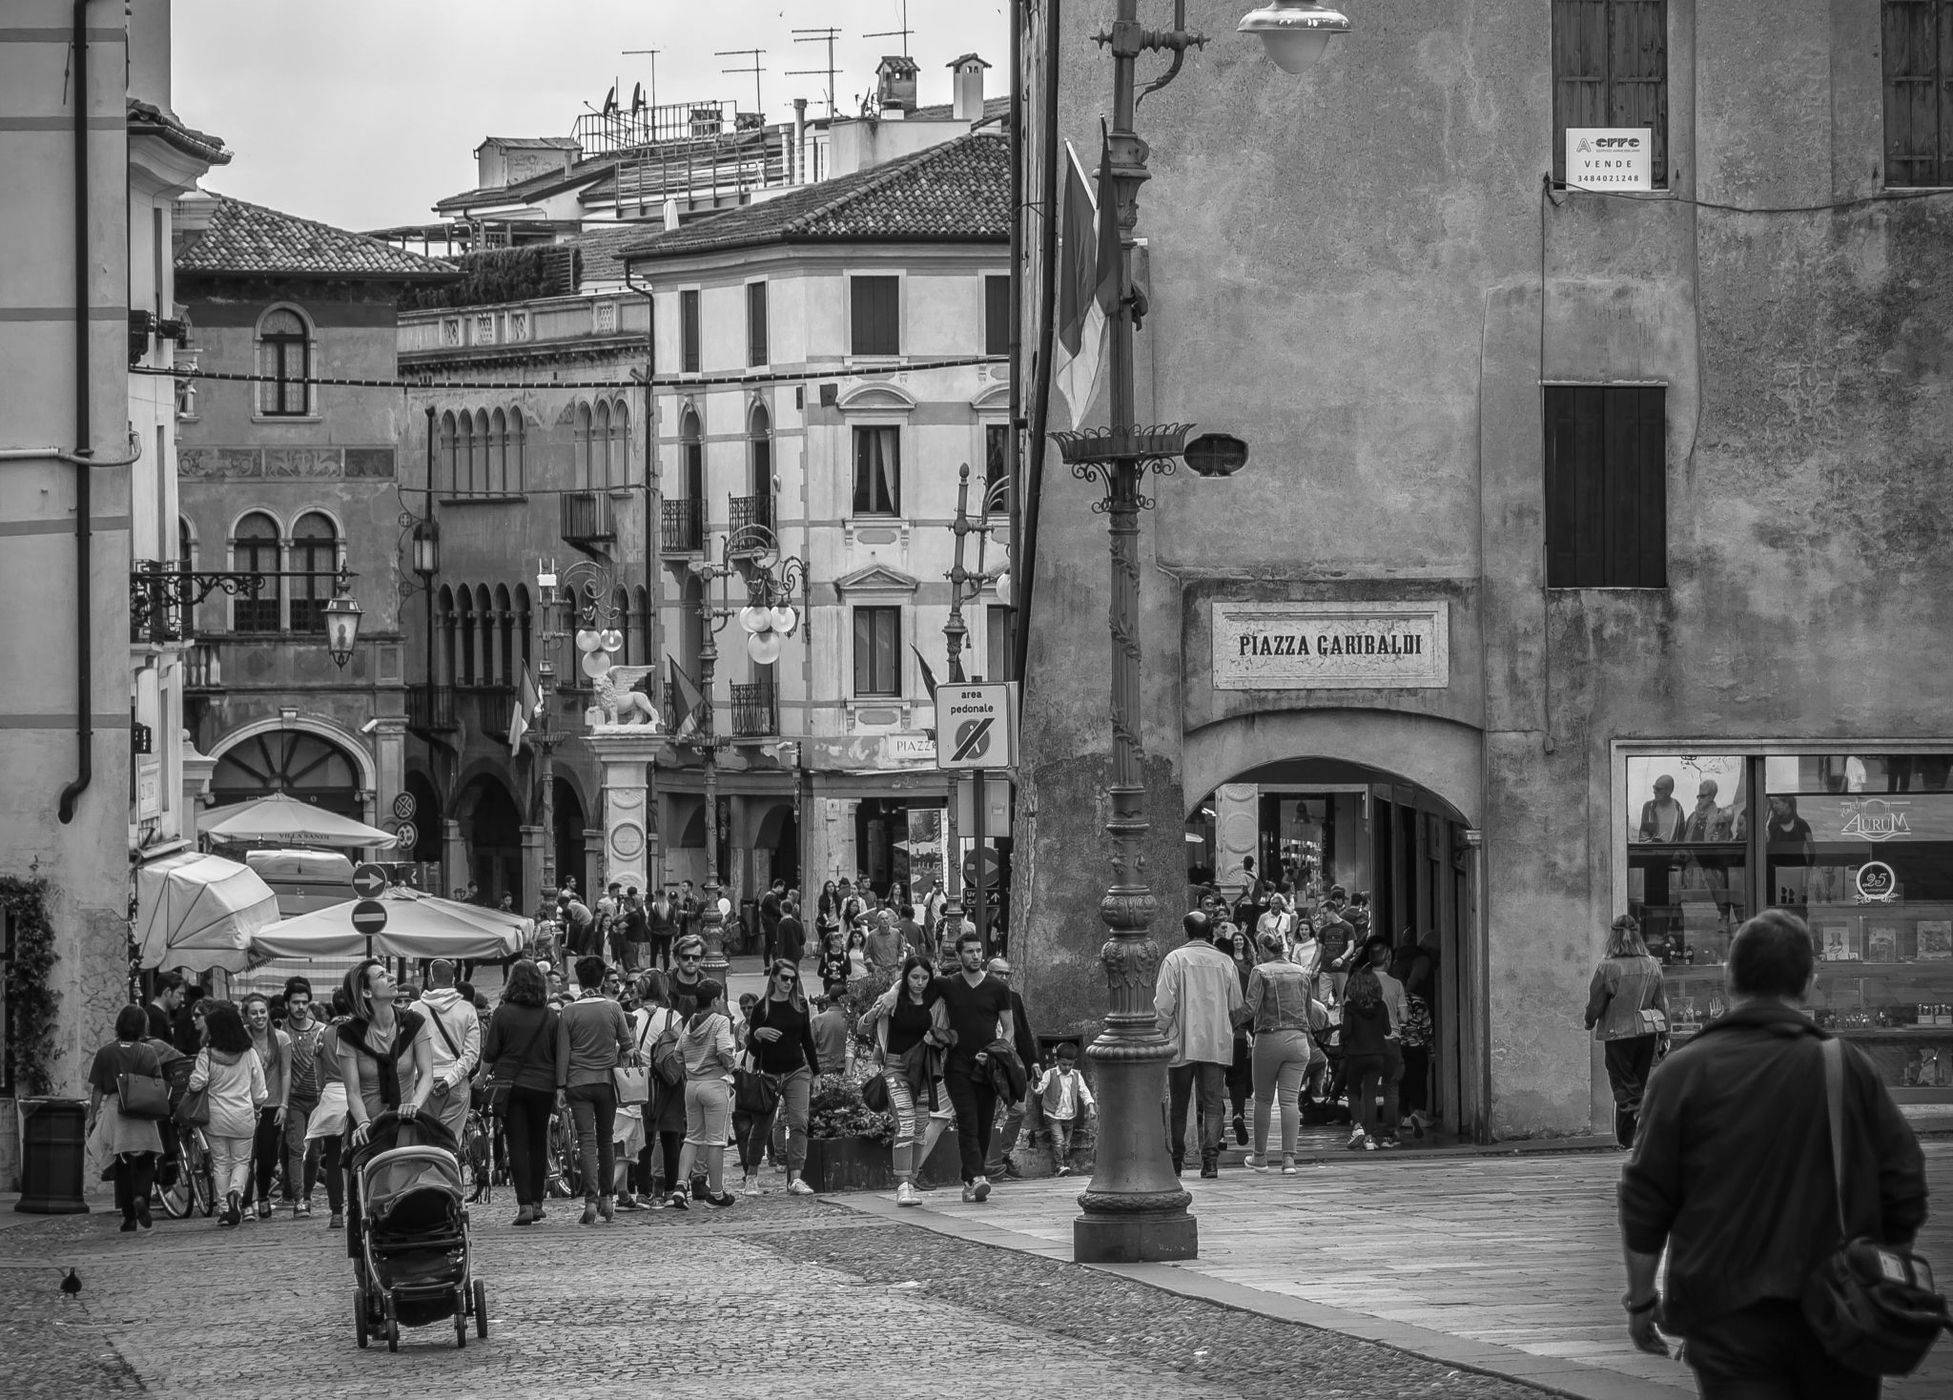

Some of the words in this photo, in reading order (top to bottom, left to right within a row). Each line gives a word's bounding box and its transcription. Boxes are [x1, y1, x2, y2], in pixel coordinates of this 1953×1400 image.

[1584, 160, 1632, 168] VENDE
[1239, 635, 1310, 656] PIAZZA
[1317, 634, 1422, 655] GARIBALDI
[961, 691, 983, 699] area
[950, 703, 994, 715] pedonale
[1841, 812, 1911, 833] AURUM
[1862, 873, 1887, 887] 25
